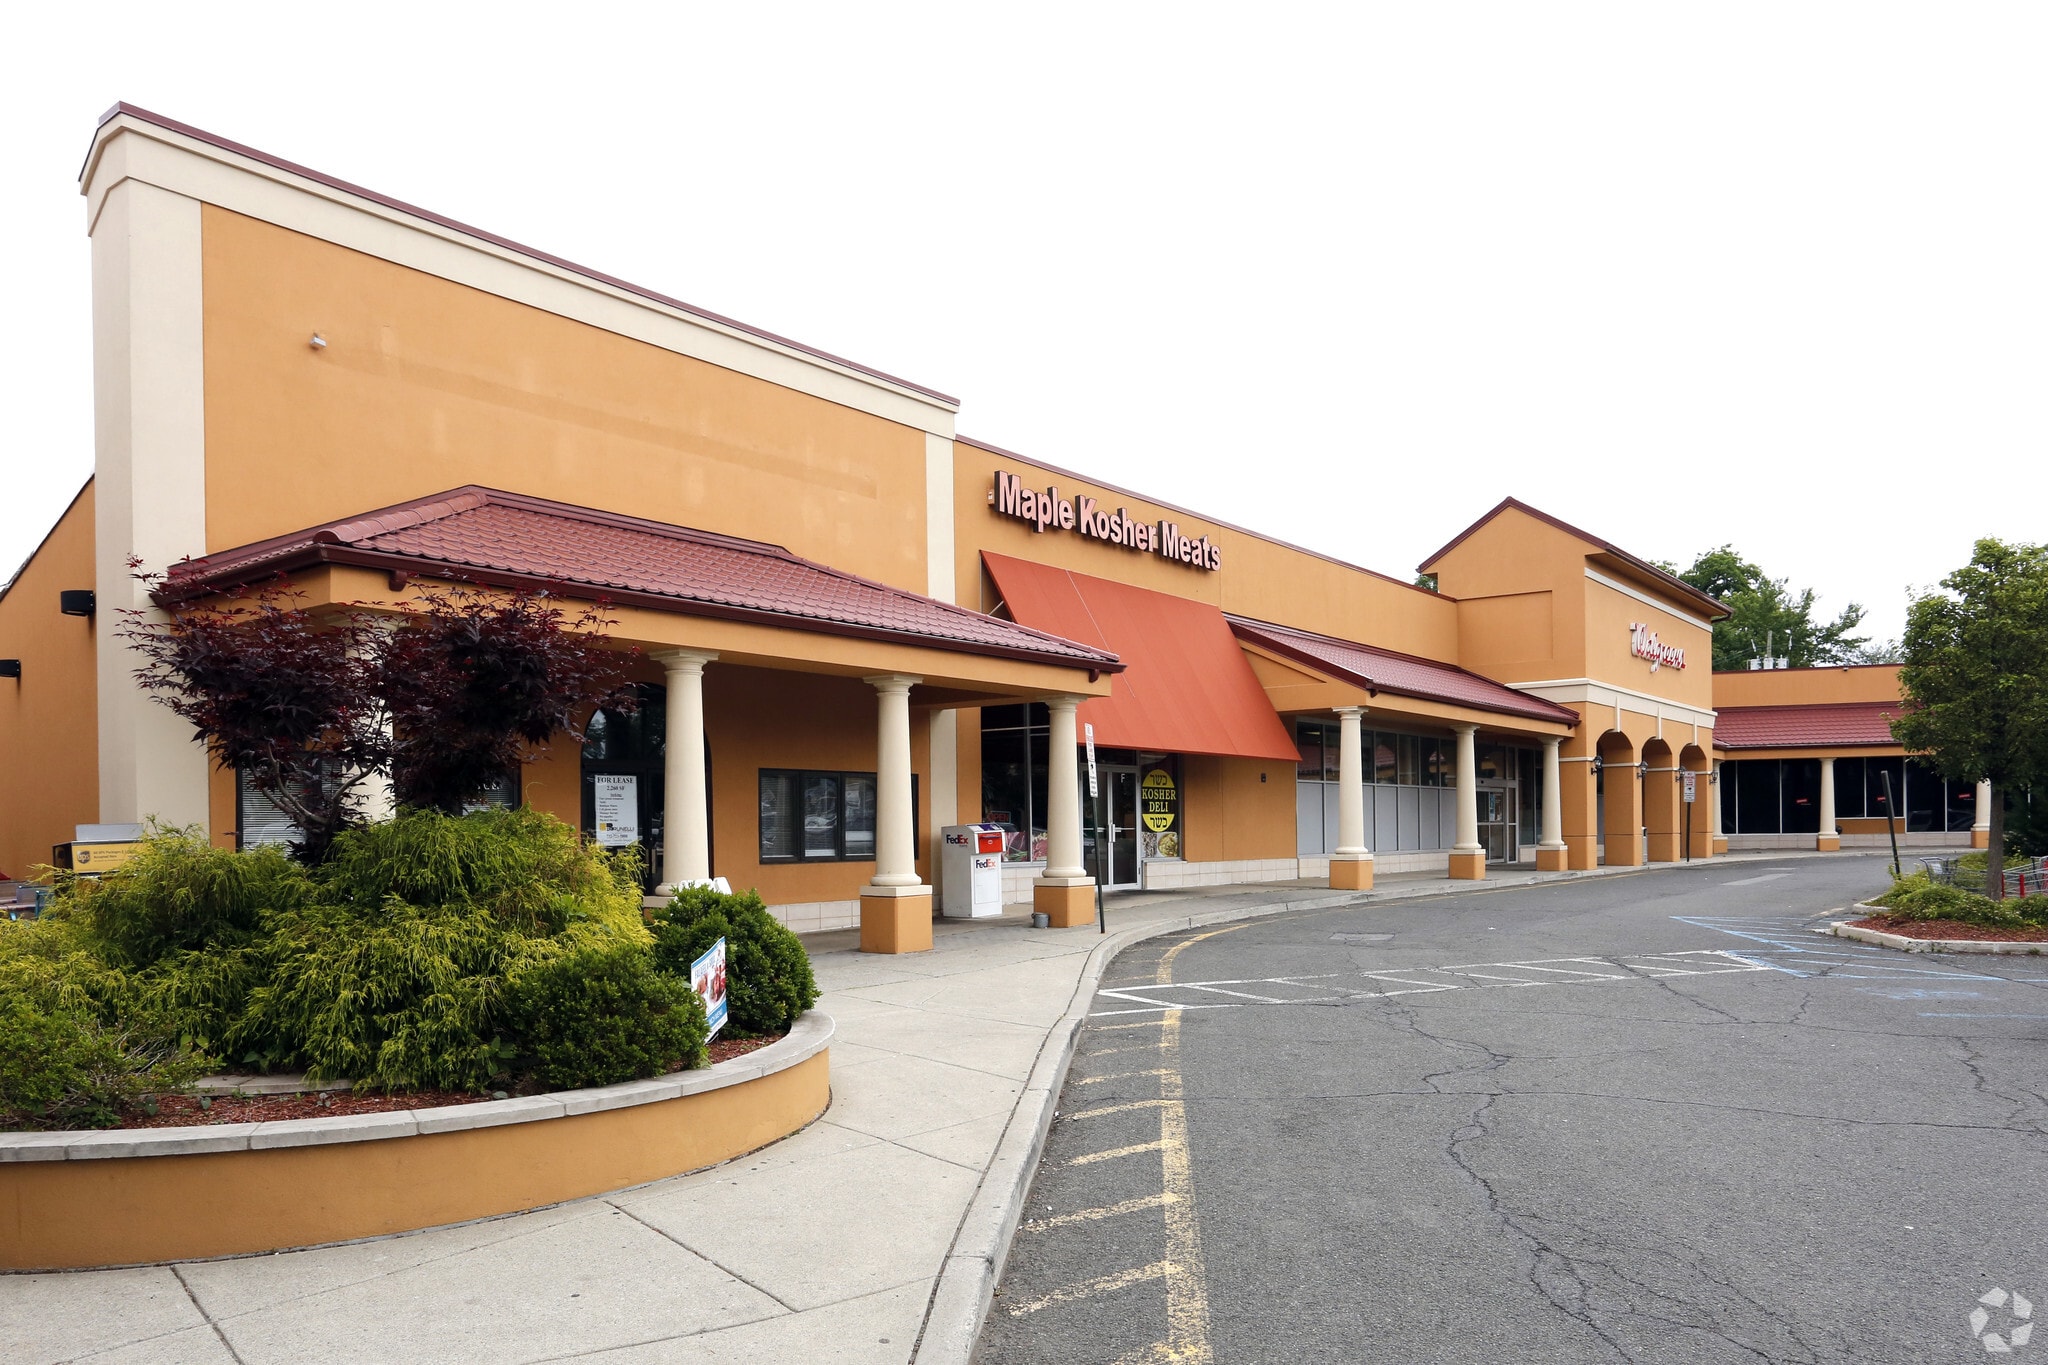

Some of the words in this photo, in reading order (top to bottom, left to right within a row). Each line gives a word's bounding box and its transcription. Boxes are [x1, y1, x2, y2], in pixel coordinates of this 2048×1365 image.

[995, 470, 1074, 533] Maple
[1076, 495, 1157, 552] Kosher
[1158, 520, 1221, 571] Meats
[1142, 788, 1176, 800] KOSHER
[1149, 801, 1169, 813] DELI
[1150, 817, 1168, 828] כשר
[946, 834, 968, 844] FedEx
[976, 859, 996, 868] FedEx
